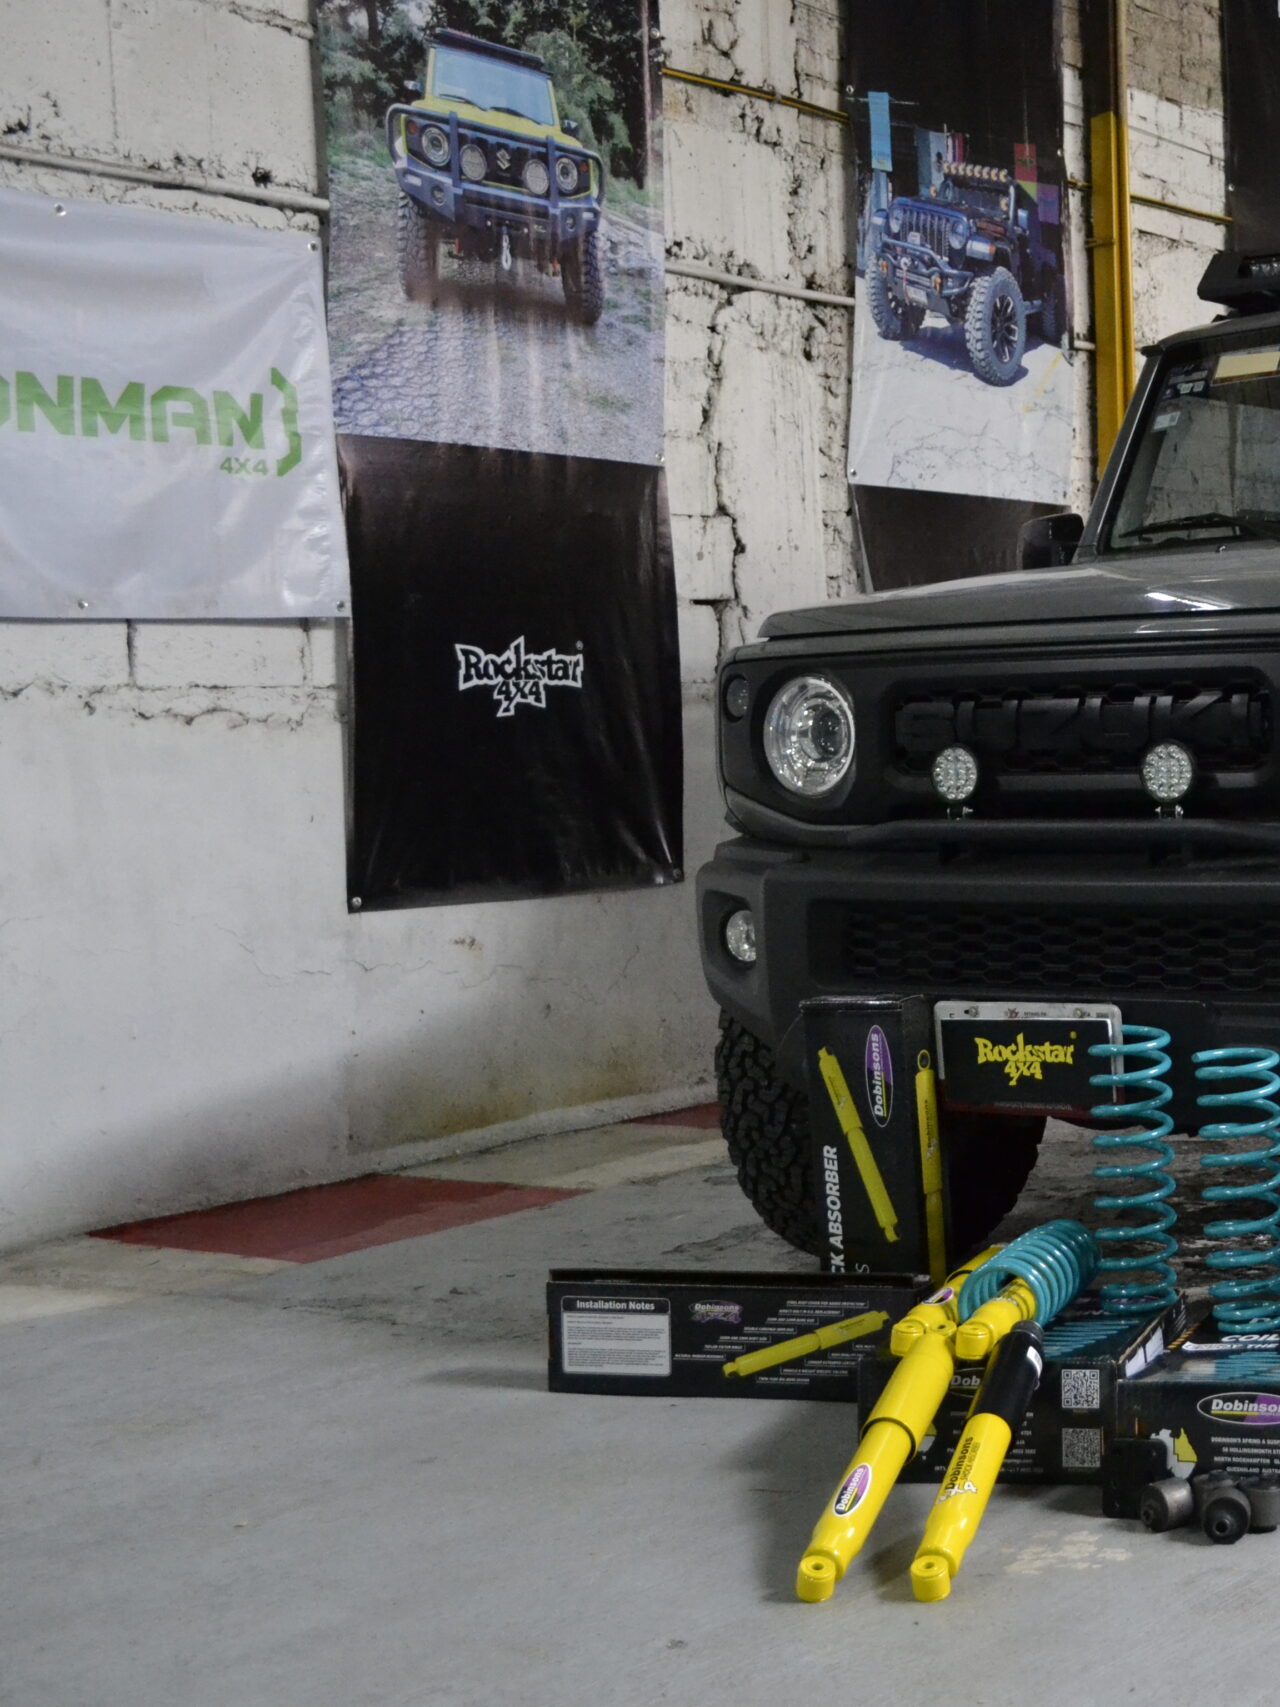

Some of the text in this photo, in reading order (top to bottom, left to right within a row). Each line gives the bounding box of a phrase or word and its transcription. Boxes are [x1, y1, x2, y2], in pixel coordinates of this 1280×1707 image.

[0, 371, 265, 450] NMAN
[455, 635, 584, 691] Rockstar
[871, 1033, 884, 1117] Dobinsons
[974, 1032, 1076, 1065] Rockstar
[823, 1145, 845, 1250] ABSORBER
[576, 1299, 656, 1311] Installation Notes
[1221, 1333, 1280, 1342] COIL
[835, 1467, 865, 1511] Dobinsons
[944, 1436, 973, 1491] Dobinsons
